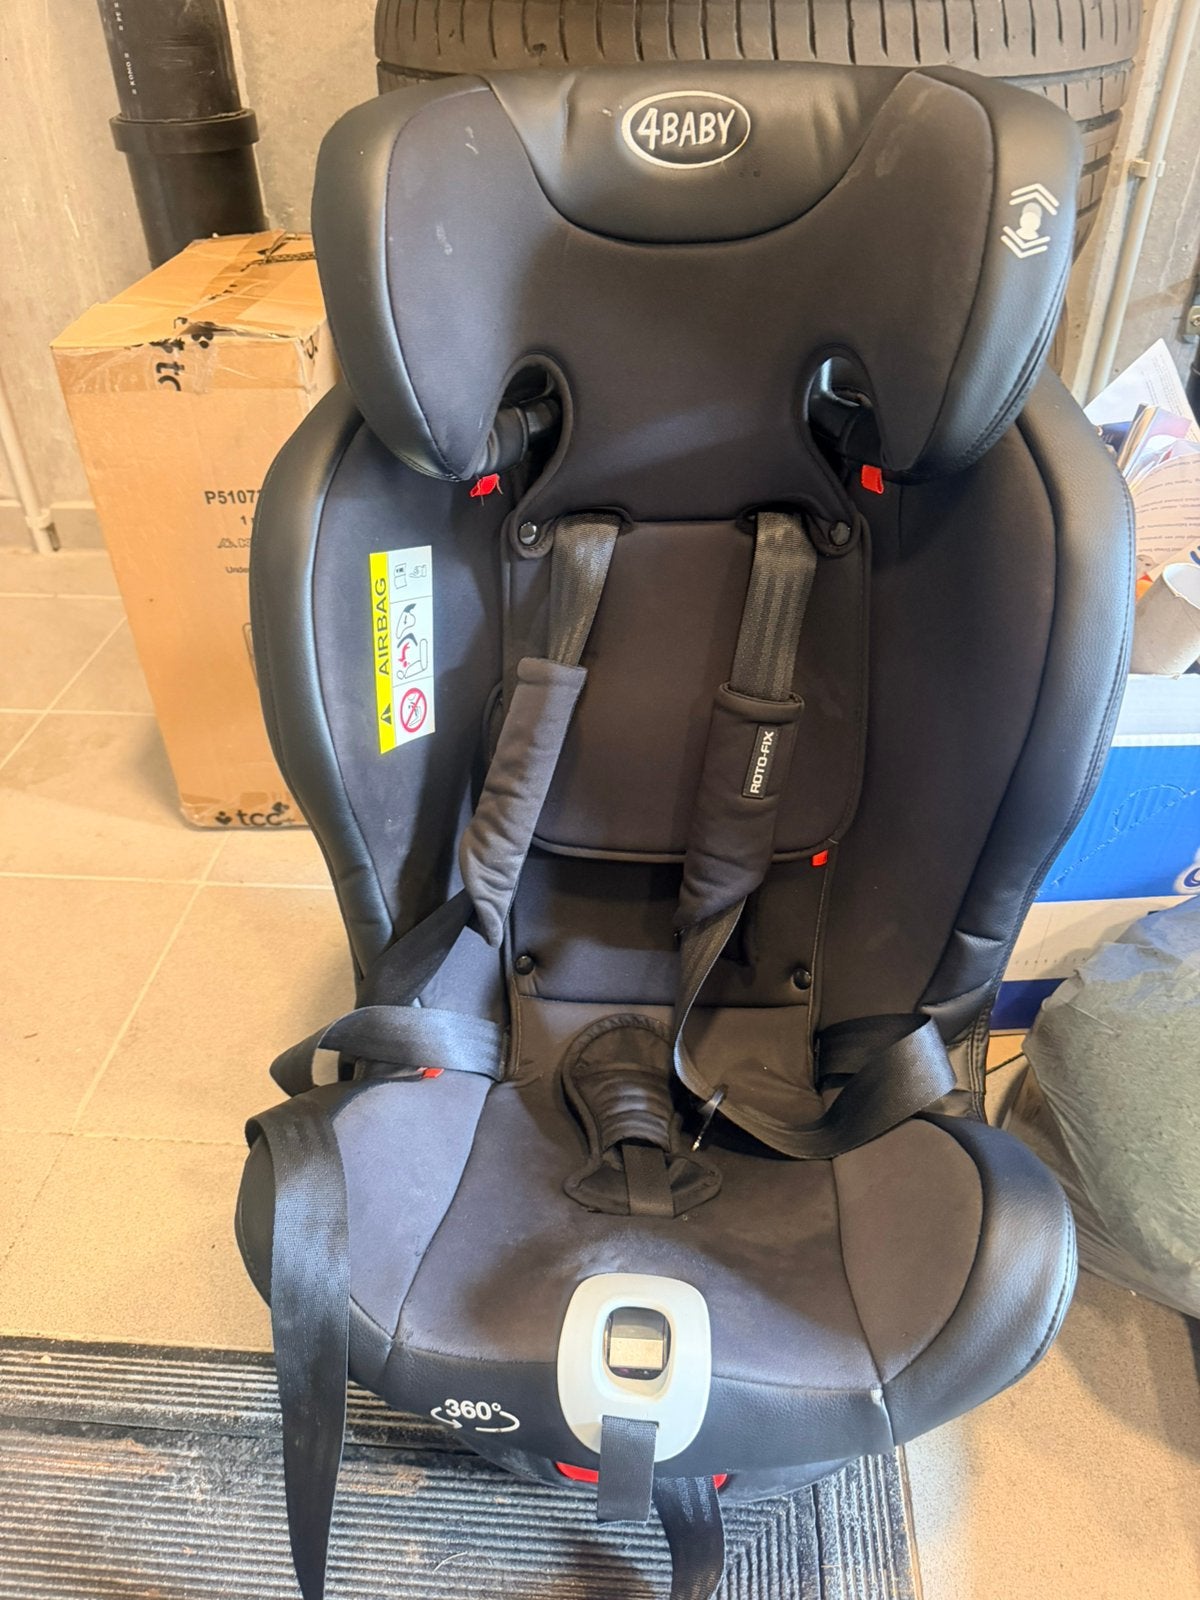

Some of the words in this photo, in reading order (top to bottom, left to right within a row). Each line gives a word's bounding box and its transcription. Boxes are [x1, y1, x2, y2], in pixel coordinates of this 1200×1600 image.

[125, 61, 136, 86] KOMO
[637, 107, 735, 151] 4BABY
[374, 577, 390, 676] AIRBAG
[749, 731, 774, 794] ROTO-FIX
